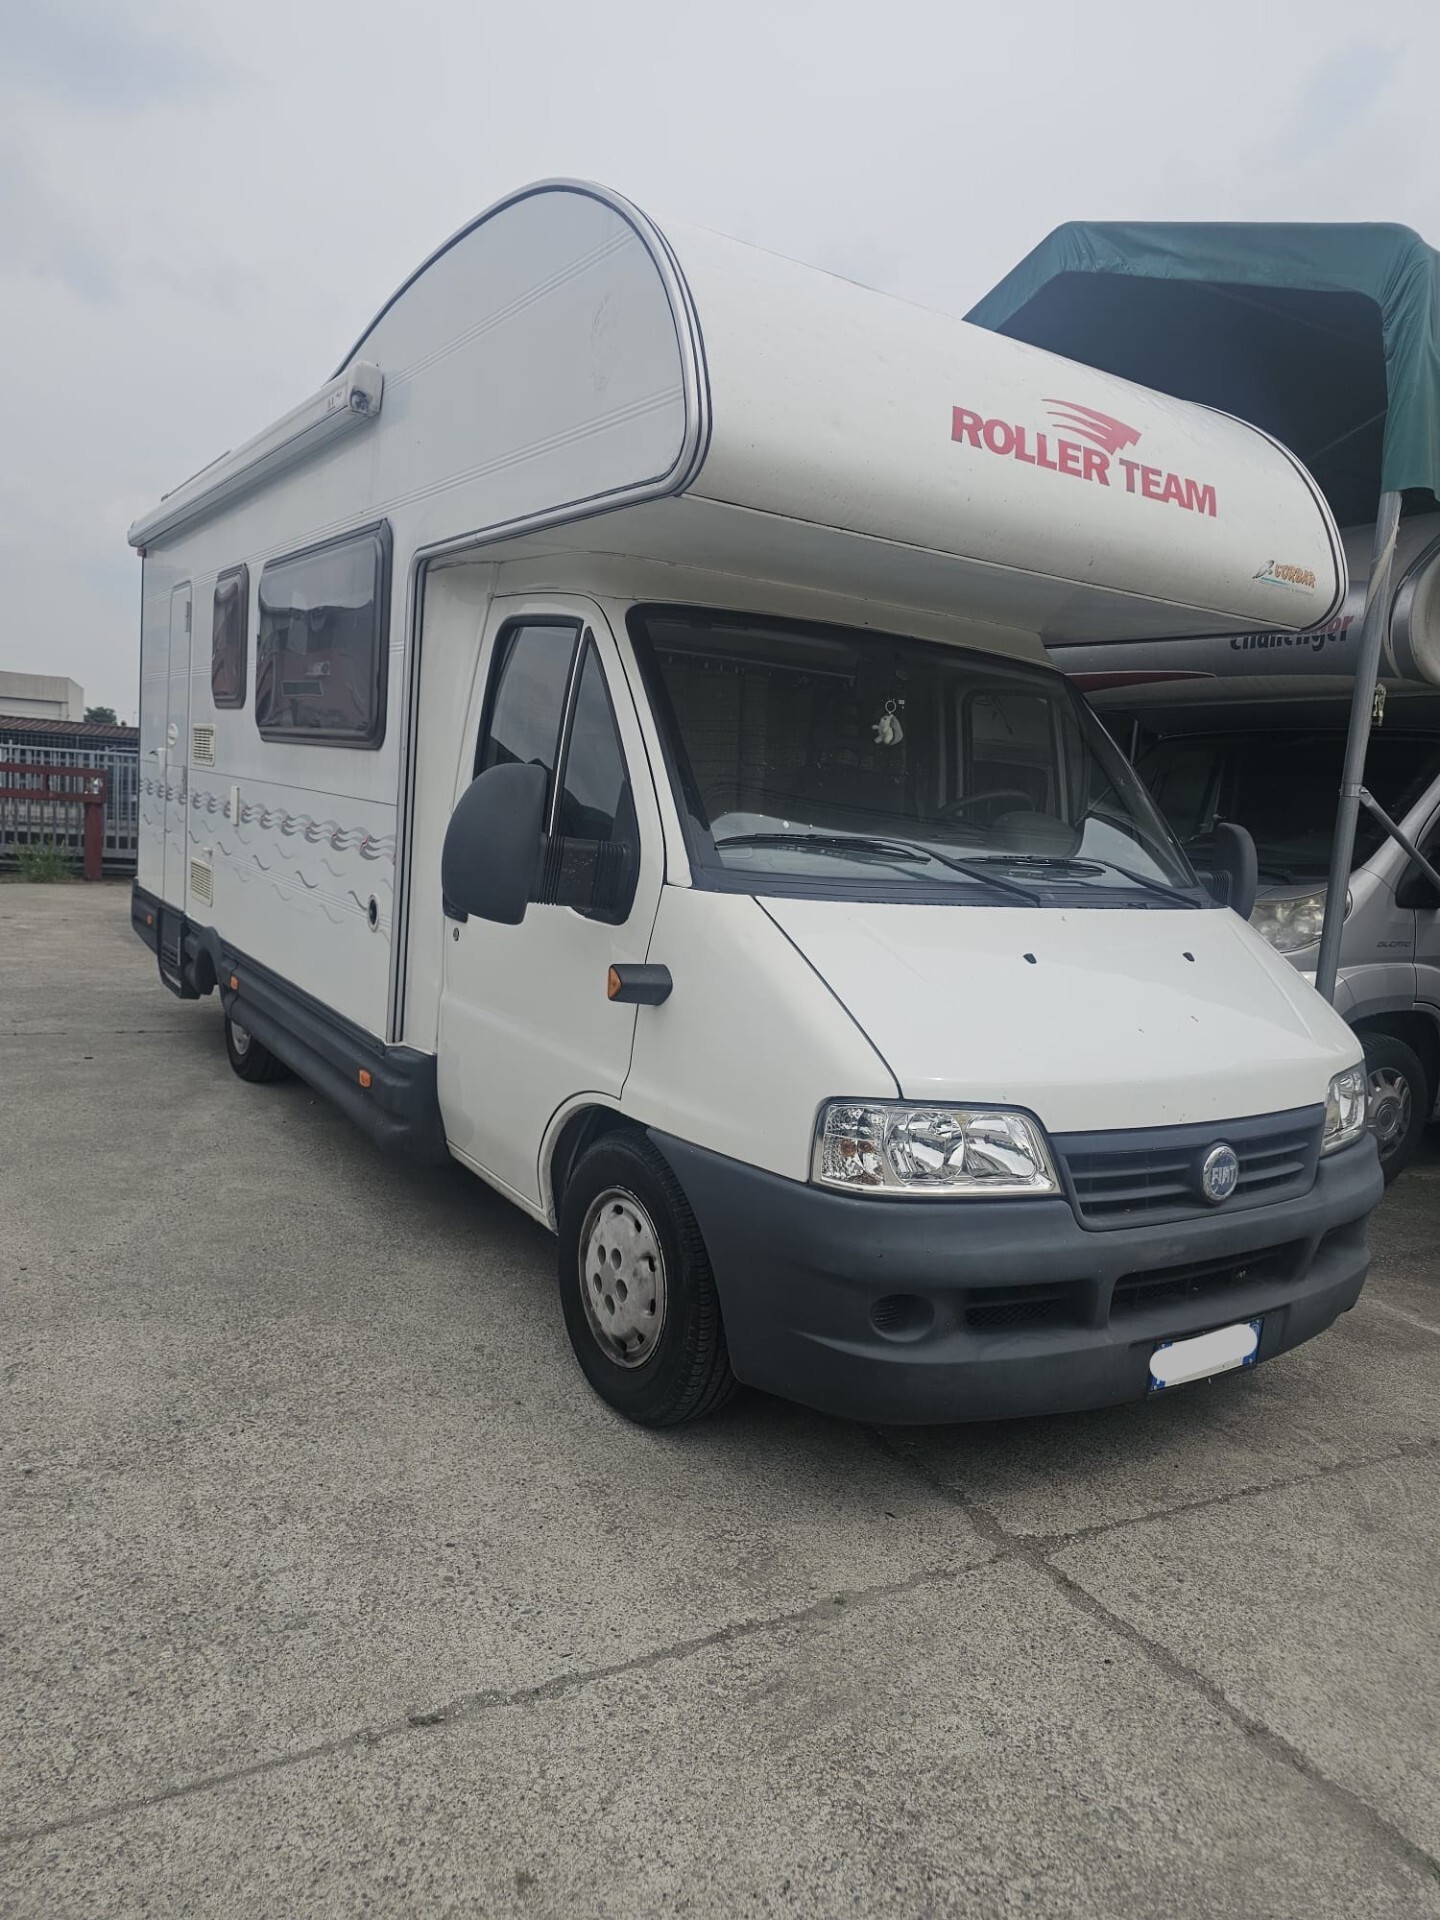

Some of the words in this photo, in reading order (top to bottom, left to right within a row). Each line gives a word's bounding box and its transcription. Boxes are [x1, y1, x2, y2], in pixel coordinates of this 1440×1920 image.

[951, 405, 1110, 487] ROLLER
[1119, 457, 1217, 518] TEAM
[1211, 1164, 1236, 1186] FIAT
